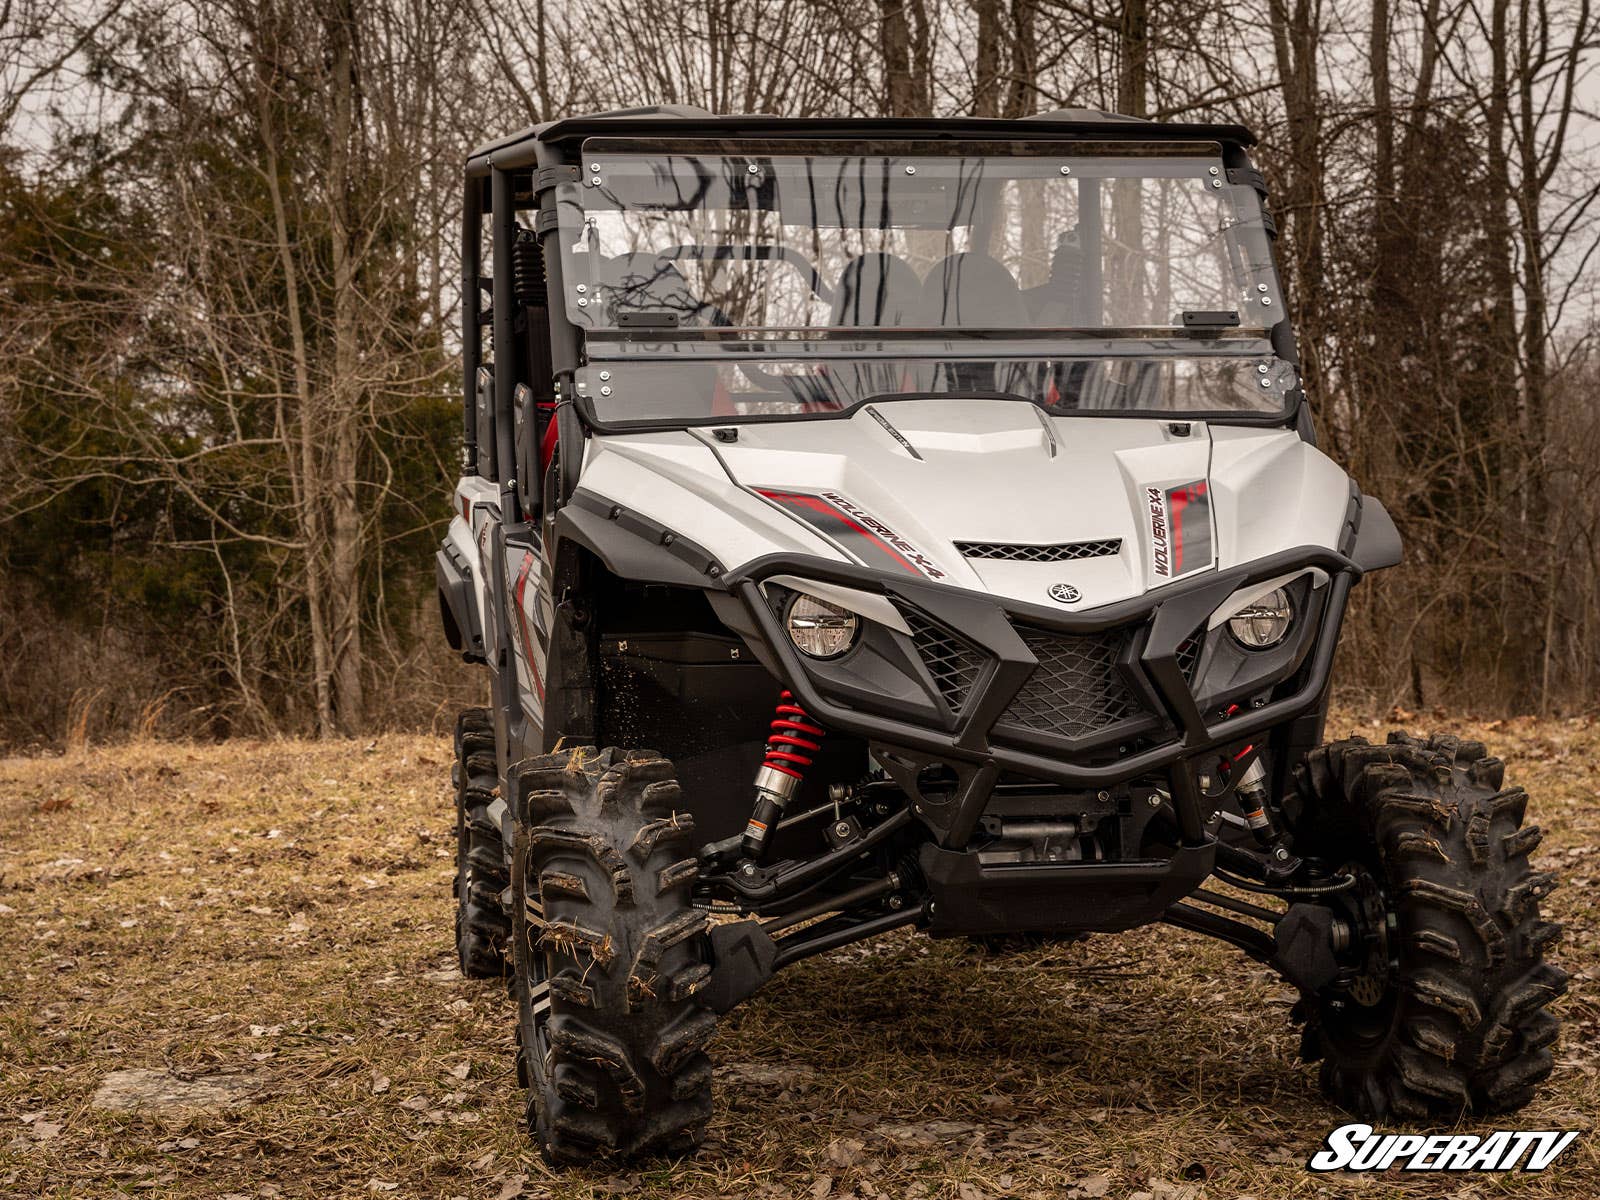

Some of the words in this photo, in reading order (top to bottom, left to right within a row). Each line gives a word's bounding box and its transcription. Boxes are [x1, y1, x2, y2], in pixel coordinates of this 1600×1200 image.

[1147, 487, 1162, 506] X4
[822, 492, 917, 552] WOLVERINE
[907, 553, 945, 579] X4
[1150, 504, 1169, 577] WOLVERINE
